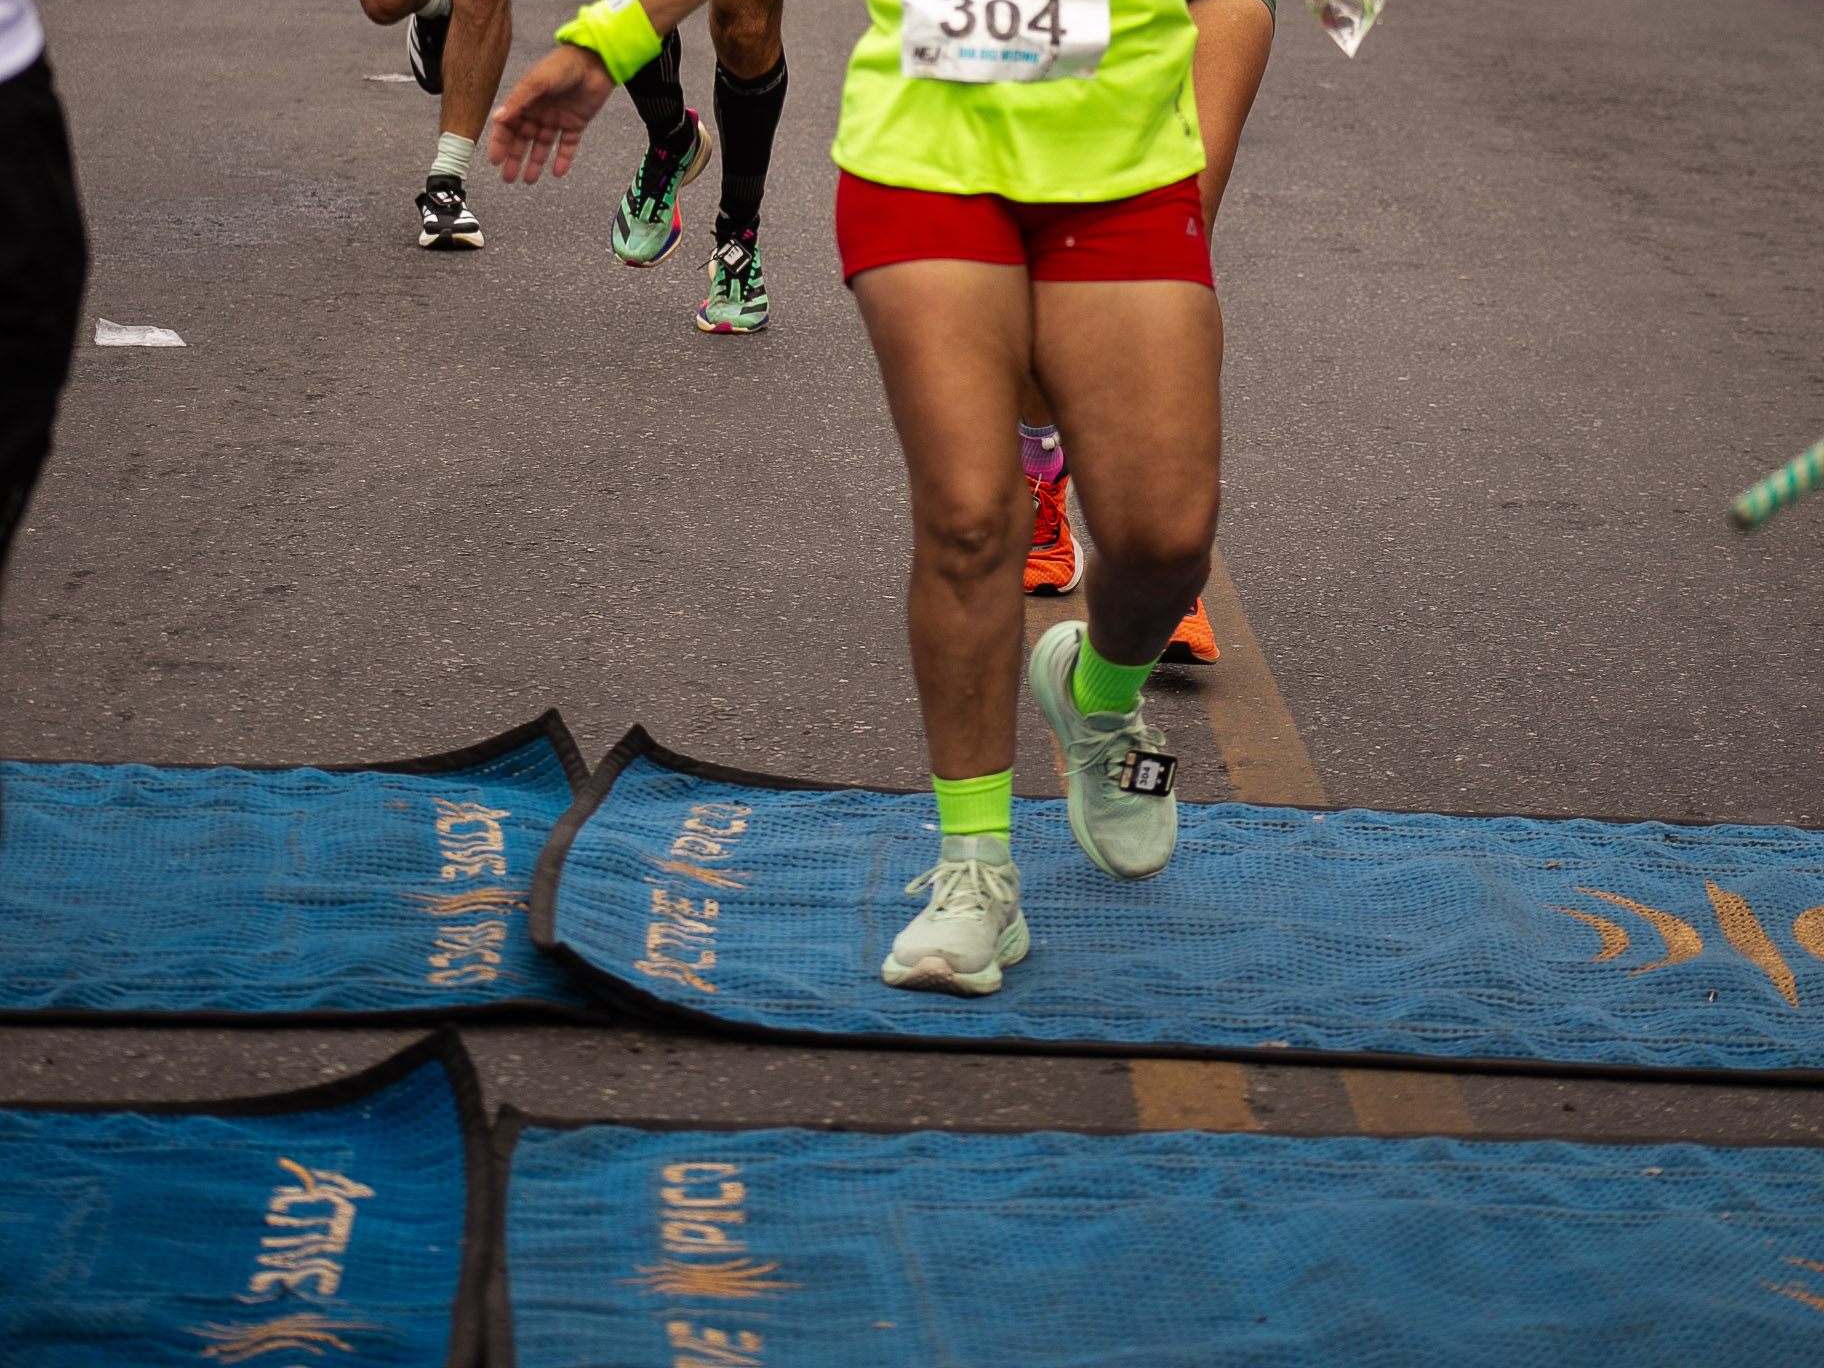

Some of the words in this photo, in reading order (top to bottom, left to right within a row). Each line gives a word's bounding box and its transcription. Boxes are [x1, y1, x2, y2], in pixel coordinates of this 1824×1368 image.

[1139, 766, 1151, 785] 304
[670, 803, 753, 860] PICO
[660, 1162, 748, 1253] PICO
